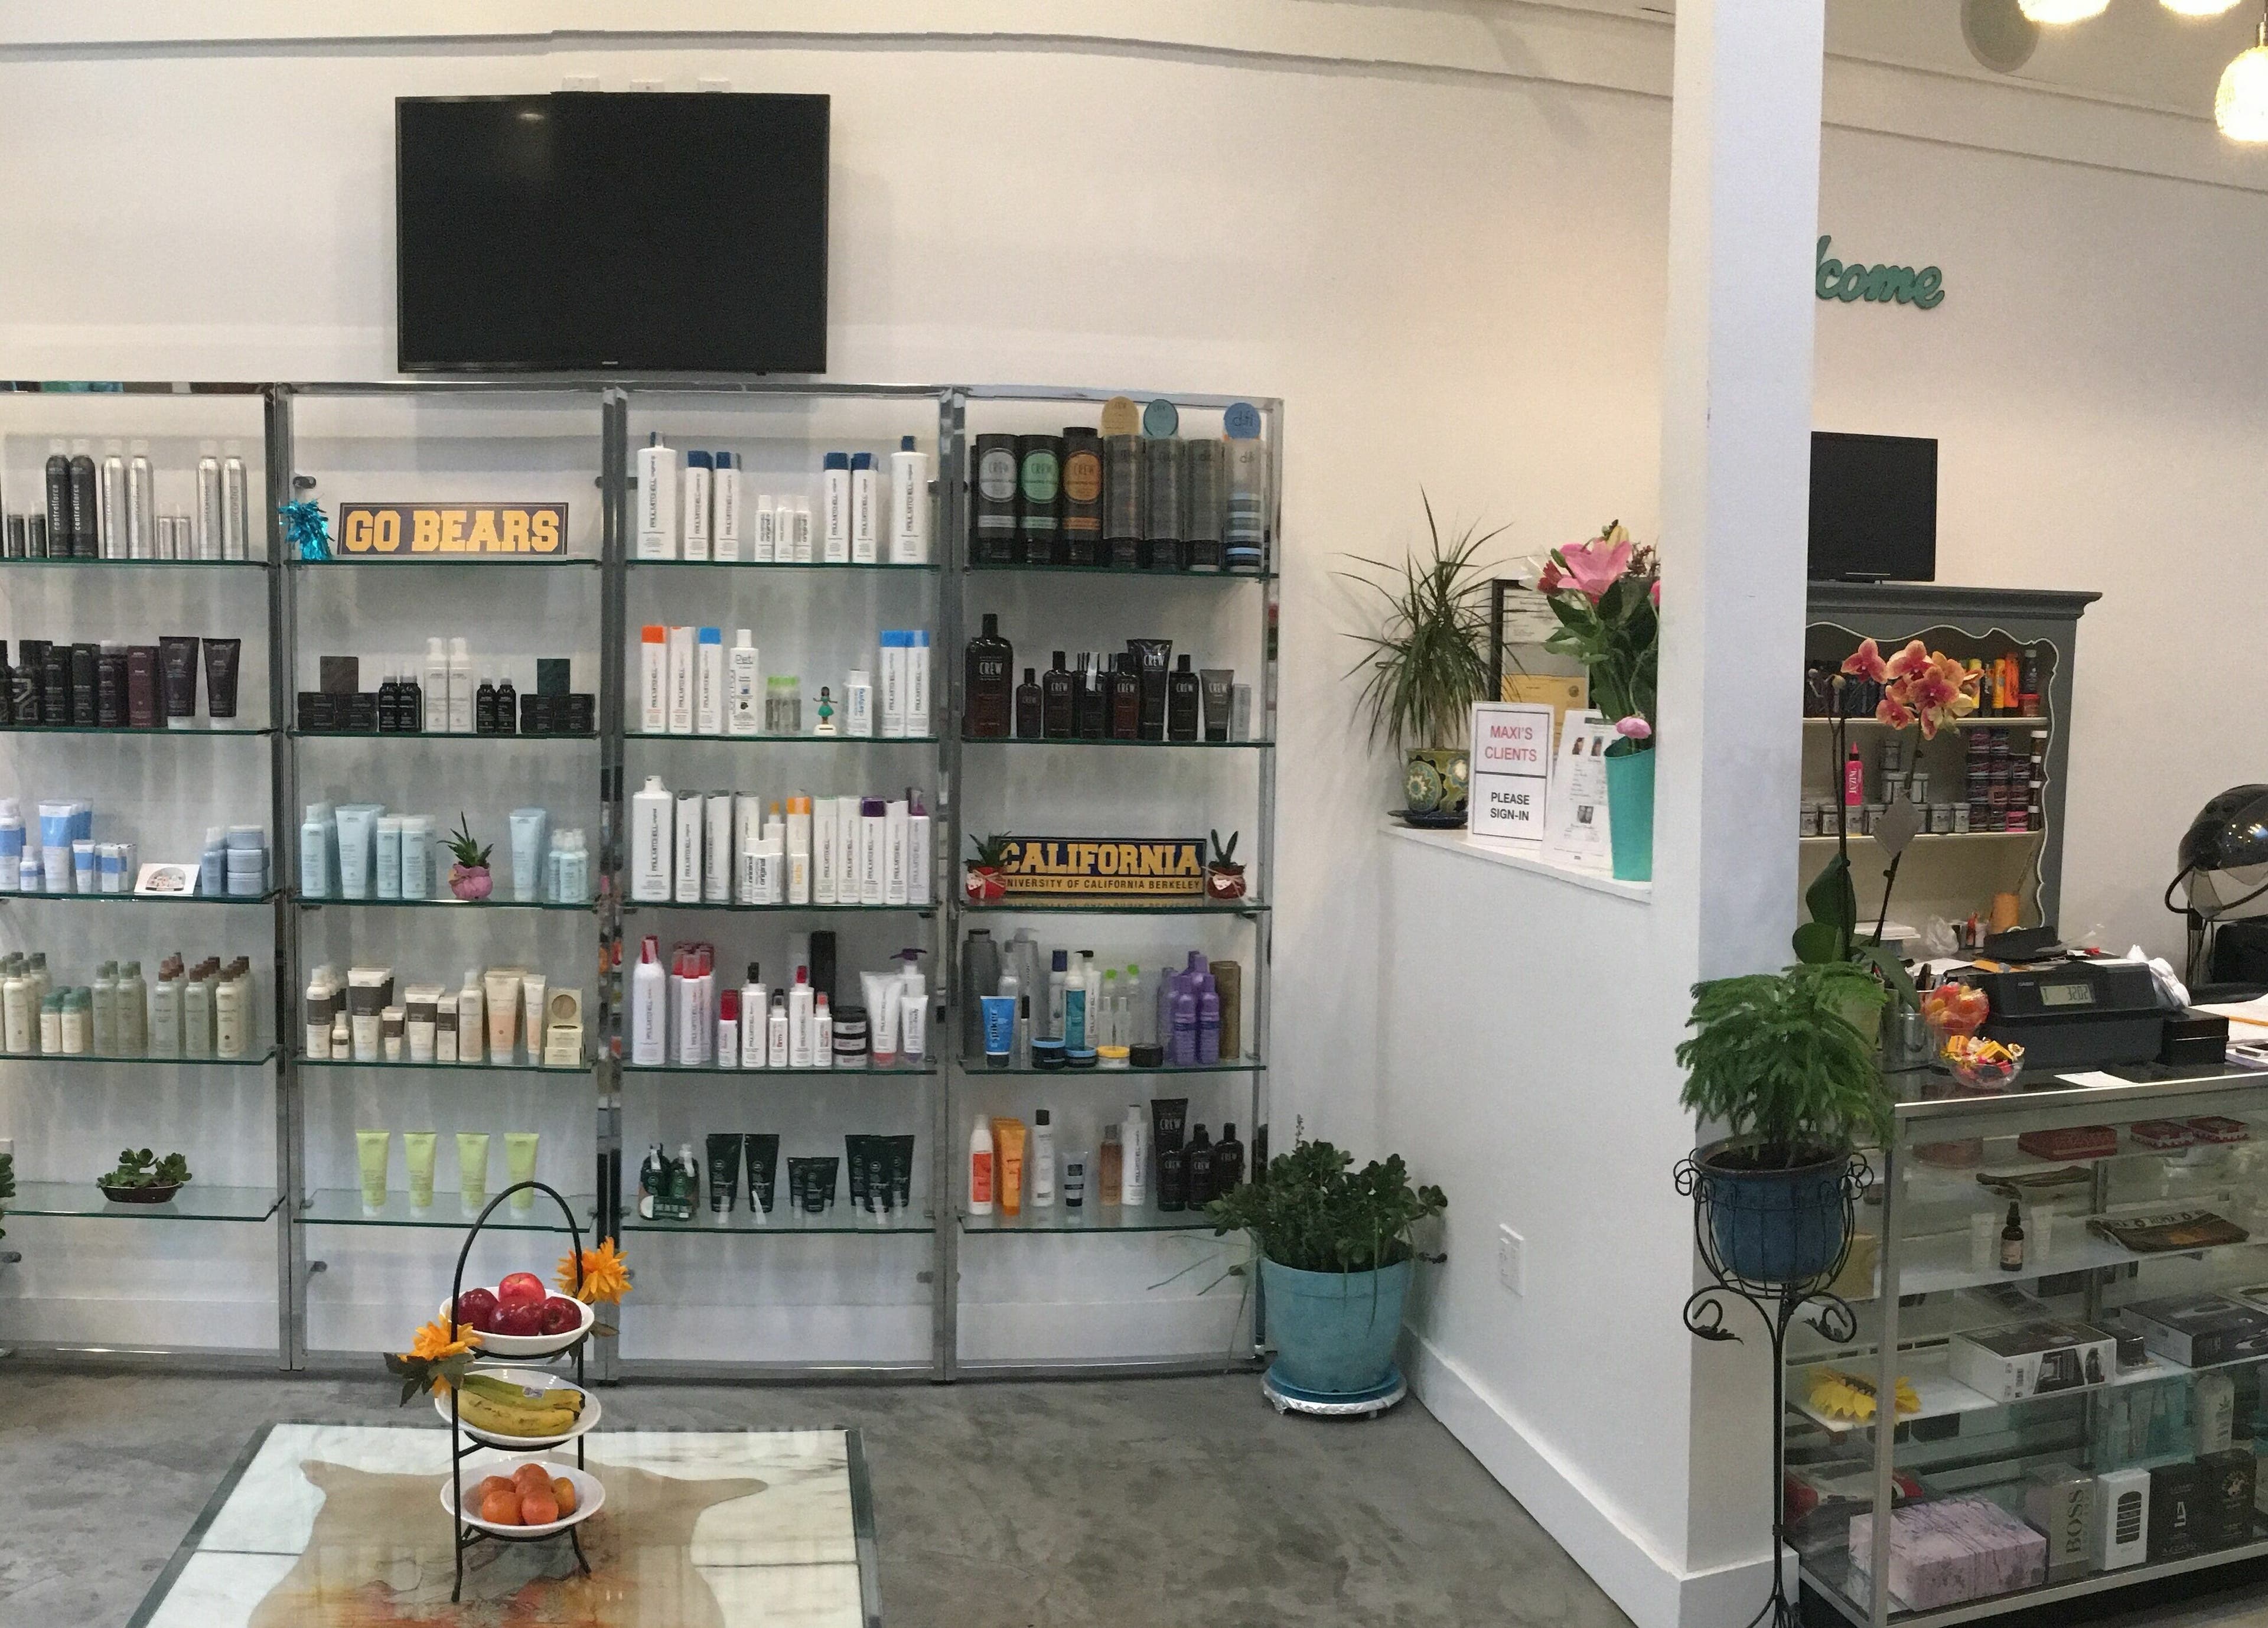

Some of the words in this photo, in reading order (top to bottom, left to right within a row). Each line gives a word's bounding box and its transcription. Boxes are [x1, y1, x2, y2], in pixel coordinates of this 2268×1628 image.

[51, 484, 60, 530] controlforce
[346, 510, 401, 552] GO
[412, 510, 560, 552] BEARS
[1143, 655, 1165, 667] CREW
[979, 662, 1003, 675] CREW
[1051, 683, 1068, 692] CREW
[1117, 683, 1135, 693] CREW
[1176, 683, 1193, 693] CREW
[1208, 683, 1228, 693] CREW
[1490, 725, 1533, 740] MAXI'S
[1485, 746, 1537, 762] CLIENTS
[1491, 792, 1530, 806] PLEASE
[1490, 808, 1530, 822] SIGN-IN
[1001, 842, 1201, 875] CALIFORNIA
[1005, 878, 1062, 888] NIVERSITY
[1067, 879, 1079, 888] OF
[1084, 879, 1144, 889] CALIFORNIA
[1149, 880, 1200, 890] BERKELEY
[1159, 1118, 1181, 1130] CREW
[2065, 1489, 2084, 1554] BOSS
